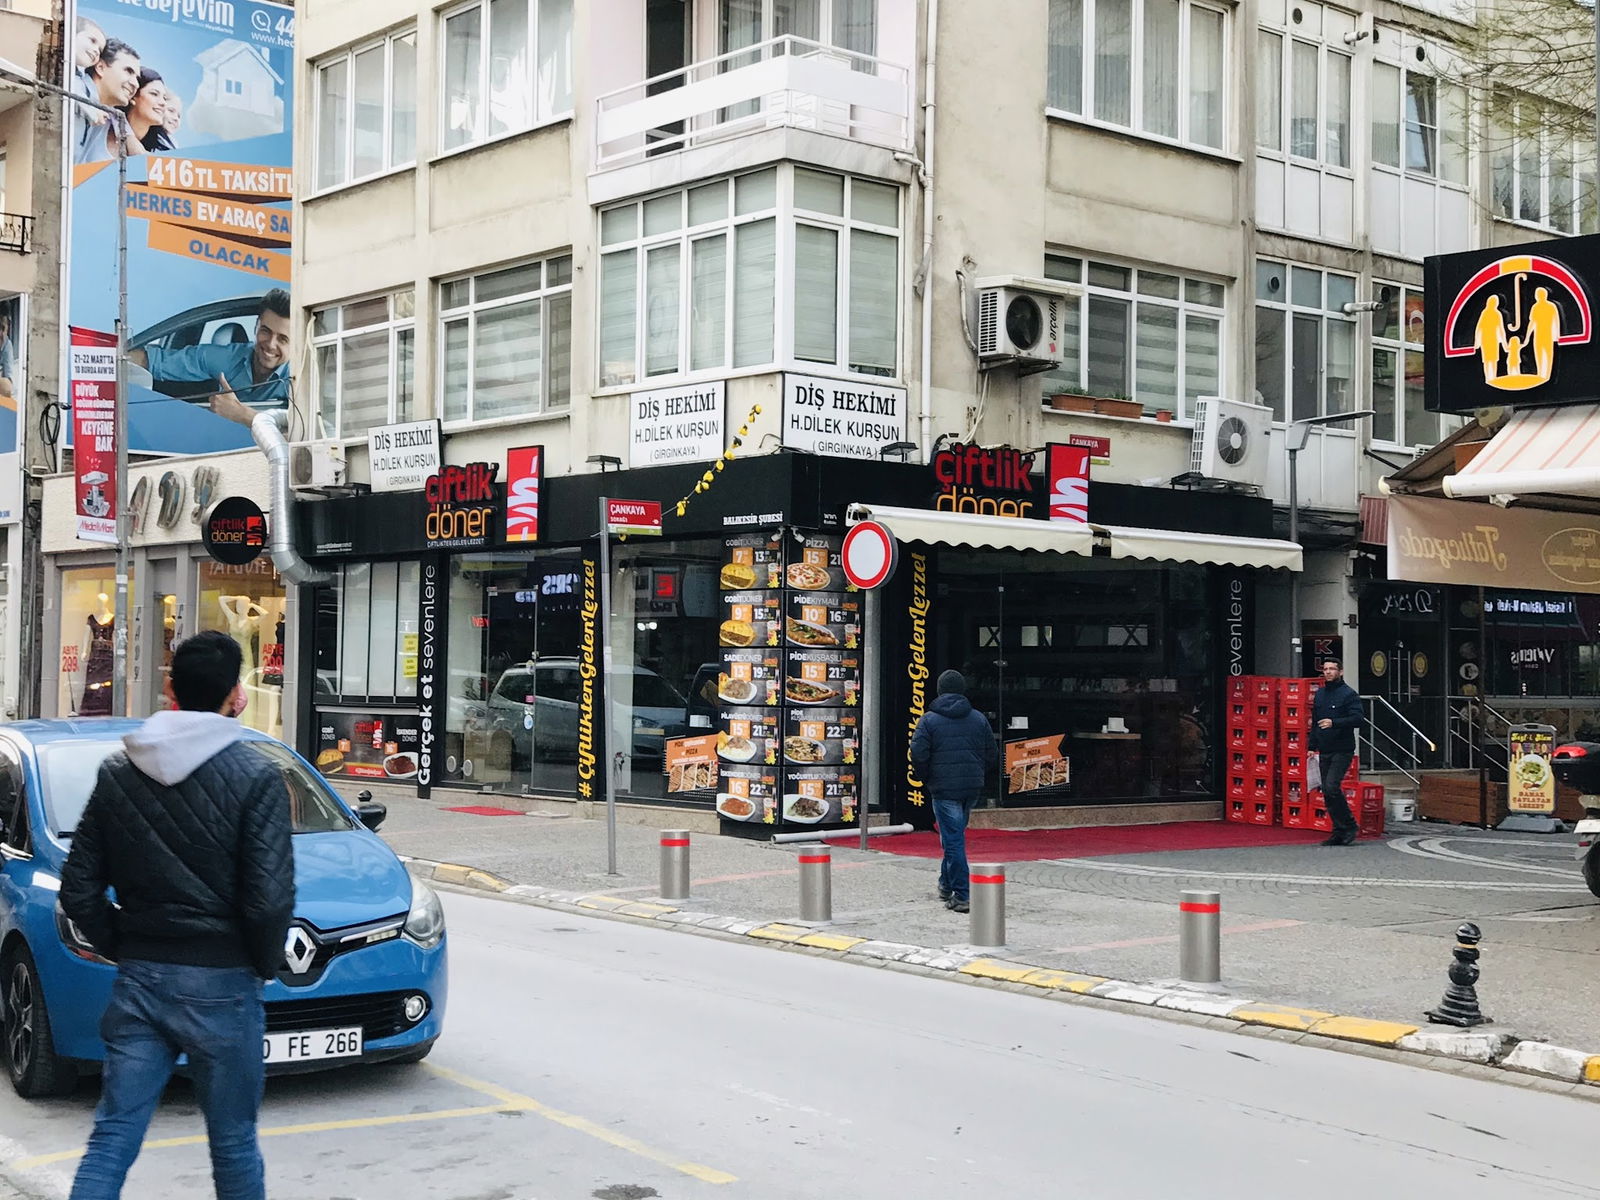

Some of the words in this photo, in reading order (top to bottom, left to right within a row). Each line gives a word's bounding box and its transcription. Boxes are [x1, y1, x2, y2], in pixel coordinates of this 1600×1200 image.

[149, 158, 194, 187] 416
[195, 168, 217, 190] TL
[126, 191, 192, 217] HERKES
[197, 201, 266, 234] EV-ARAÇ
[189, 240, 270, 272] OLACAK
[638, 396, 660, 421] DİŞ
[665, 387, 716, 416] HEKİMİ
[795, 382, 825, 411] DİŞ
[832, 390, 896, 416] HEKİMİ
[635, 424, 673, 443] H.DİLEK
[676, 420, 719, 440] KURŞUN
[791, 413, 842, 435] H.DİLEK
[847, 420, 900, 441] KURŞUN
[95, 436, 113, 452] BAK
[374, 430, 391, 452] DİŞ
[394, 425, 432, 448] HEKİMİ
[374, 454, 402, 471] H.DİLEK
[404, 452, 436, 469] KURŞUN
[935, 444, 1033, 493] çiftlik
[425, 463, 493, 511] çiftlik
[610, 504, 646, 516] ÇANKAYA
[723, 512, 758, 526] BALIKESİR
[426, 503, 492, 540] döner
[211, 529, 245, 542] döner
[805, 537, 829, 549] PİZZA
[735, 551, 743, 563] 7
[755, 551, 764, 562] 13
[806, 551, 819, 564] 15
[830, 554, 841, 565] 21
[422, 565, 435, 672] sevenlere
[735, 608, 742, 620] 9
[754, 608, 763, 619] 15
[804, 608, 818, 621] 10
[830, 610, 841, 622] 16
[753, 667, 763, 678] 19
[804, 665, 818, 678] 15
[828, 667, 840, 678] 21
[420, 674, 434, 699] et
[732, 723, 743, 736] 15
[752, 725, 763, 736] 21
[802, 724, 816, 737] 16
[826, 726, 841, 737] 22
[418, 705, 434, 785] Gerçek
[731, 782, 742, 794] 16
[750, 783, 762, 795] 22
[801, 783, 815, 796] 15
[826, 784, 837, 795] 21
[289, 1035, 311, 1057] FE
[325, 1031, 358, 1054] 266
